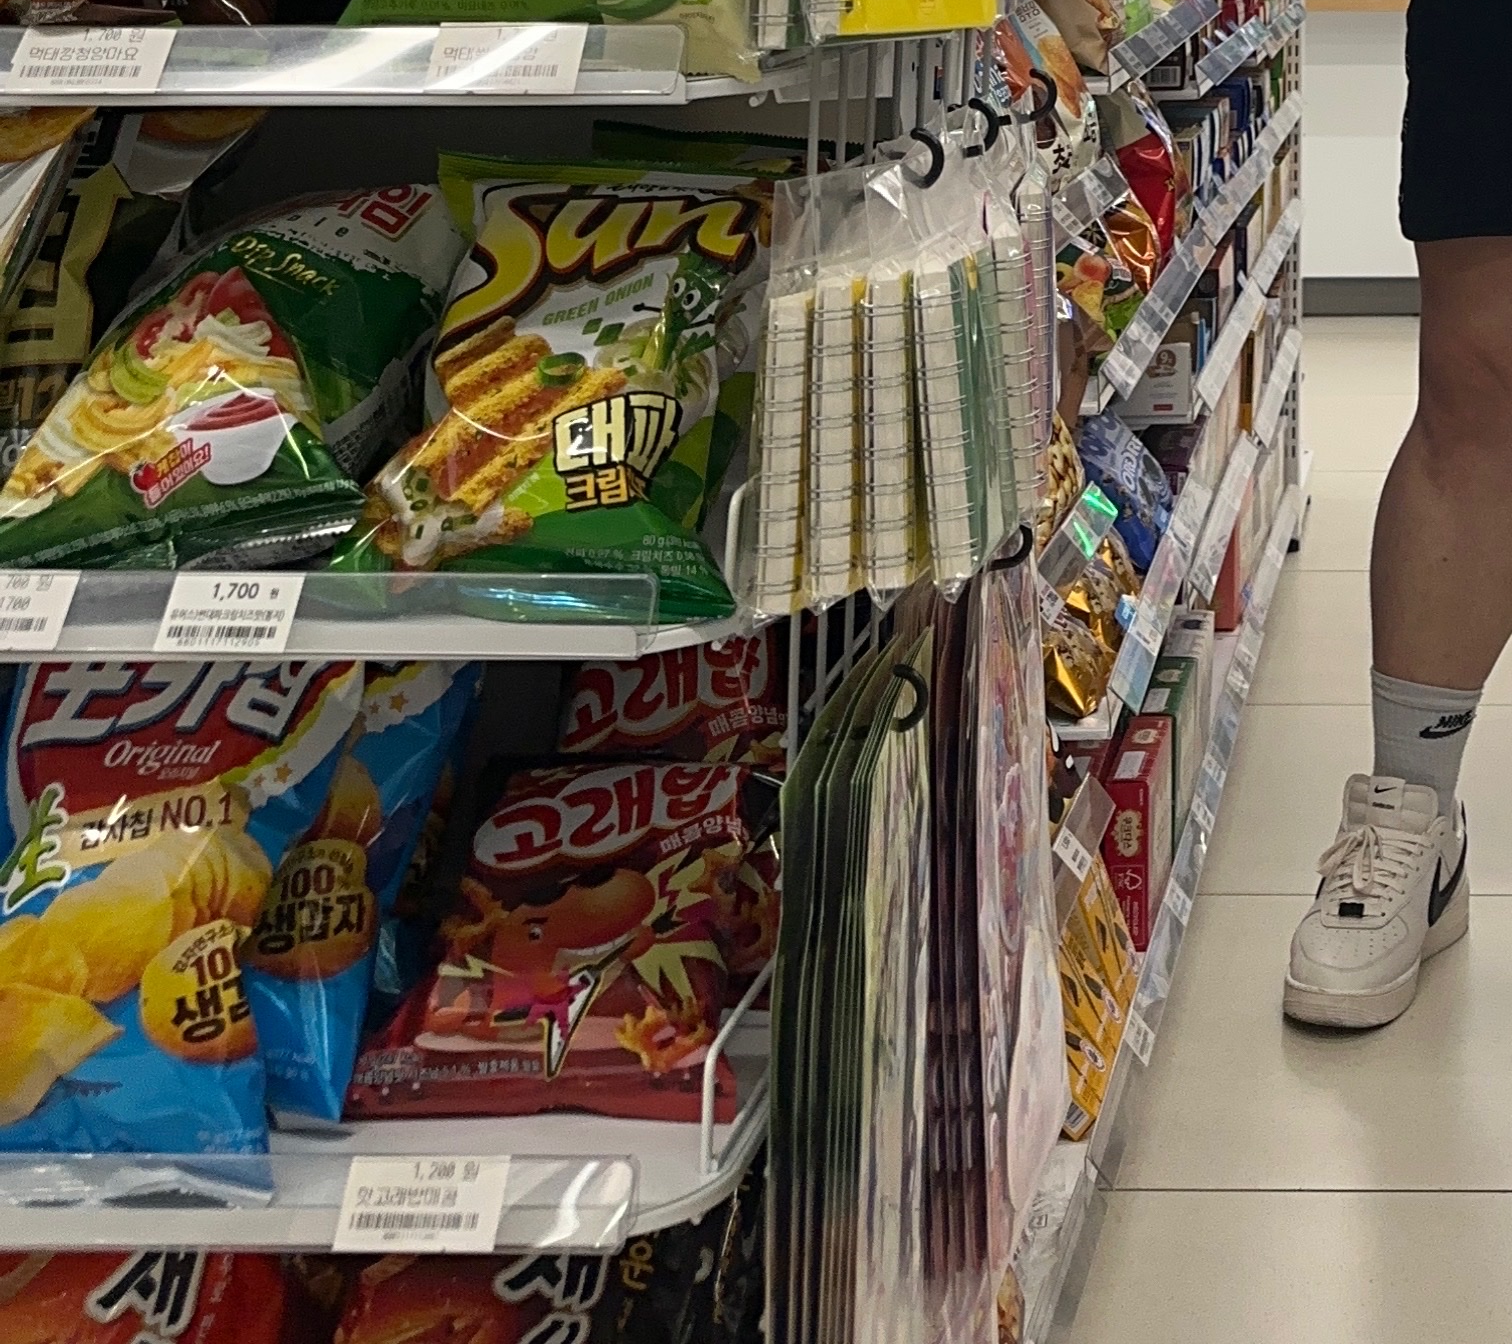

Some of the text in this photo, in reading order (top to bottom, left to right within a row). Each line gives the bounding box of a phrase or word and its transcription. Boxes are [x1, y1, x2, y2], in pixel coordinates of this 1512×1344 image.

[29, 46, 139, 62] 먹태깡청양마요
[231, 236, 339, 297] Dip Snack
[435, 184, 758, 346] Sun
[542, 275, 656, 327] GREEN ONION
[553, 392, 683, 480] 대파
[212, 582, 260, 601] 1,700
[104, 738, 221, 770] Original
[159, 792, 233, 833] NO.1
[491, 765, 731, 864] 고래밥
[251, 894, 366, 955] 생감자
[414, 1162, 456, 1179] 1,200
